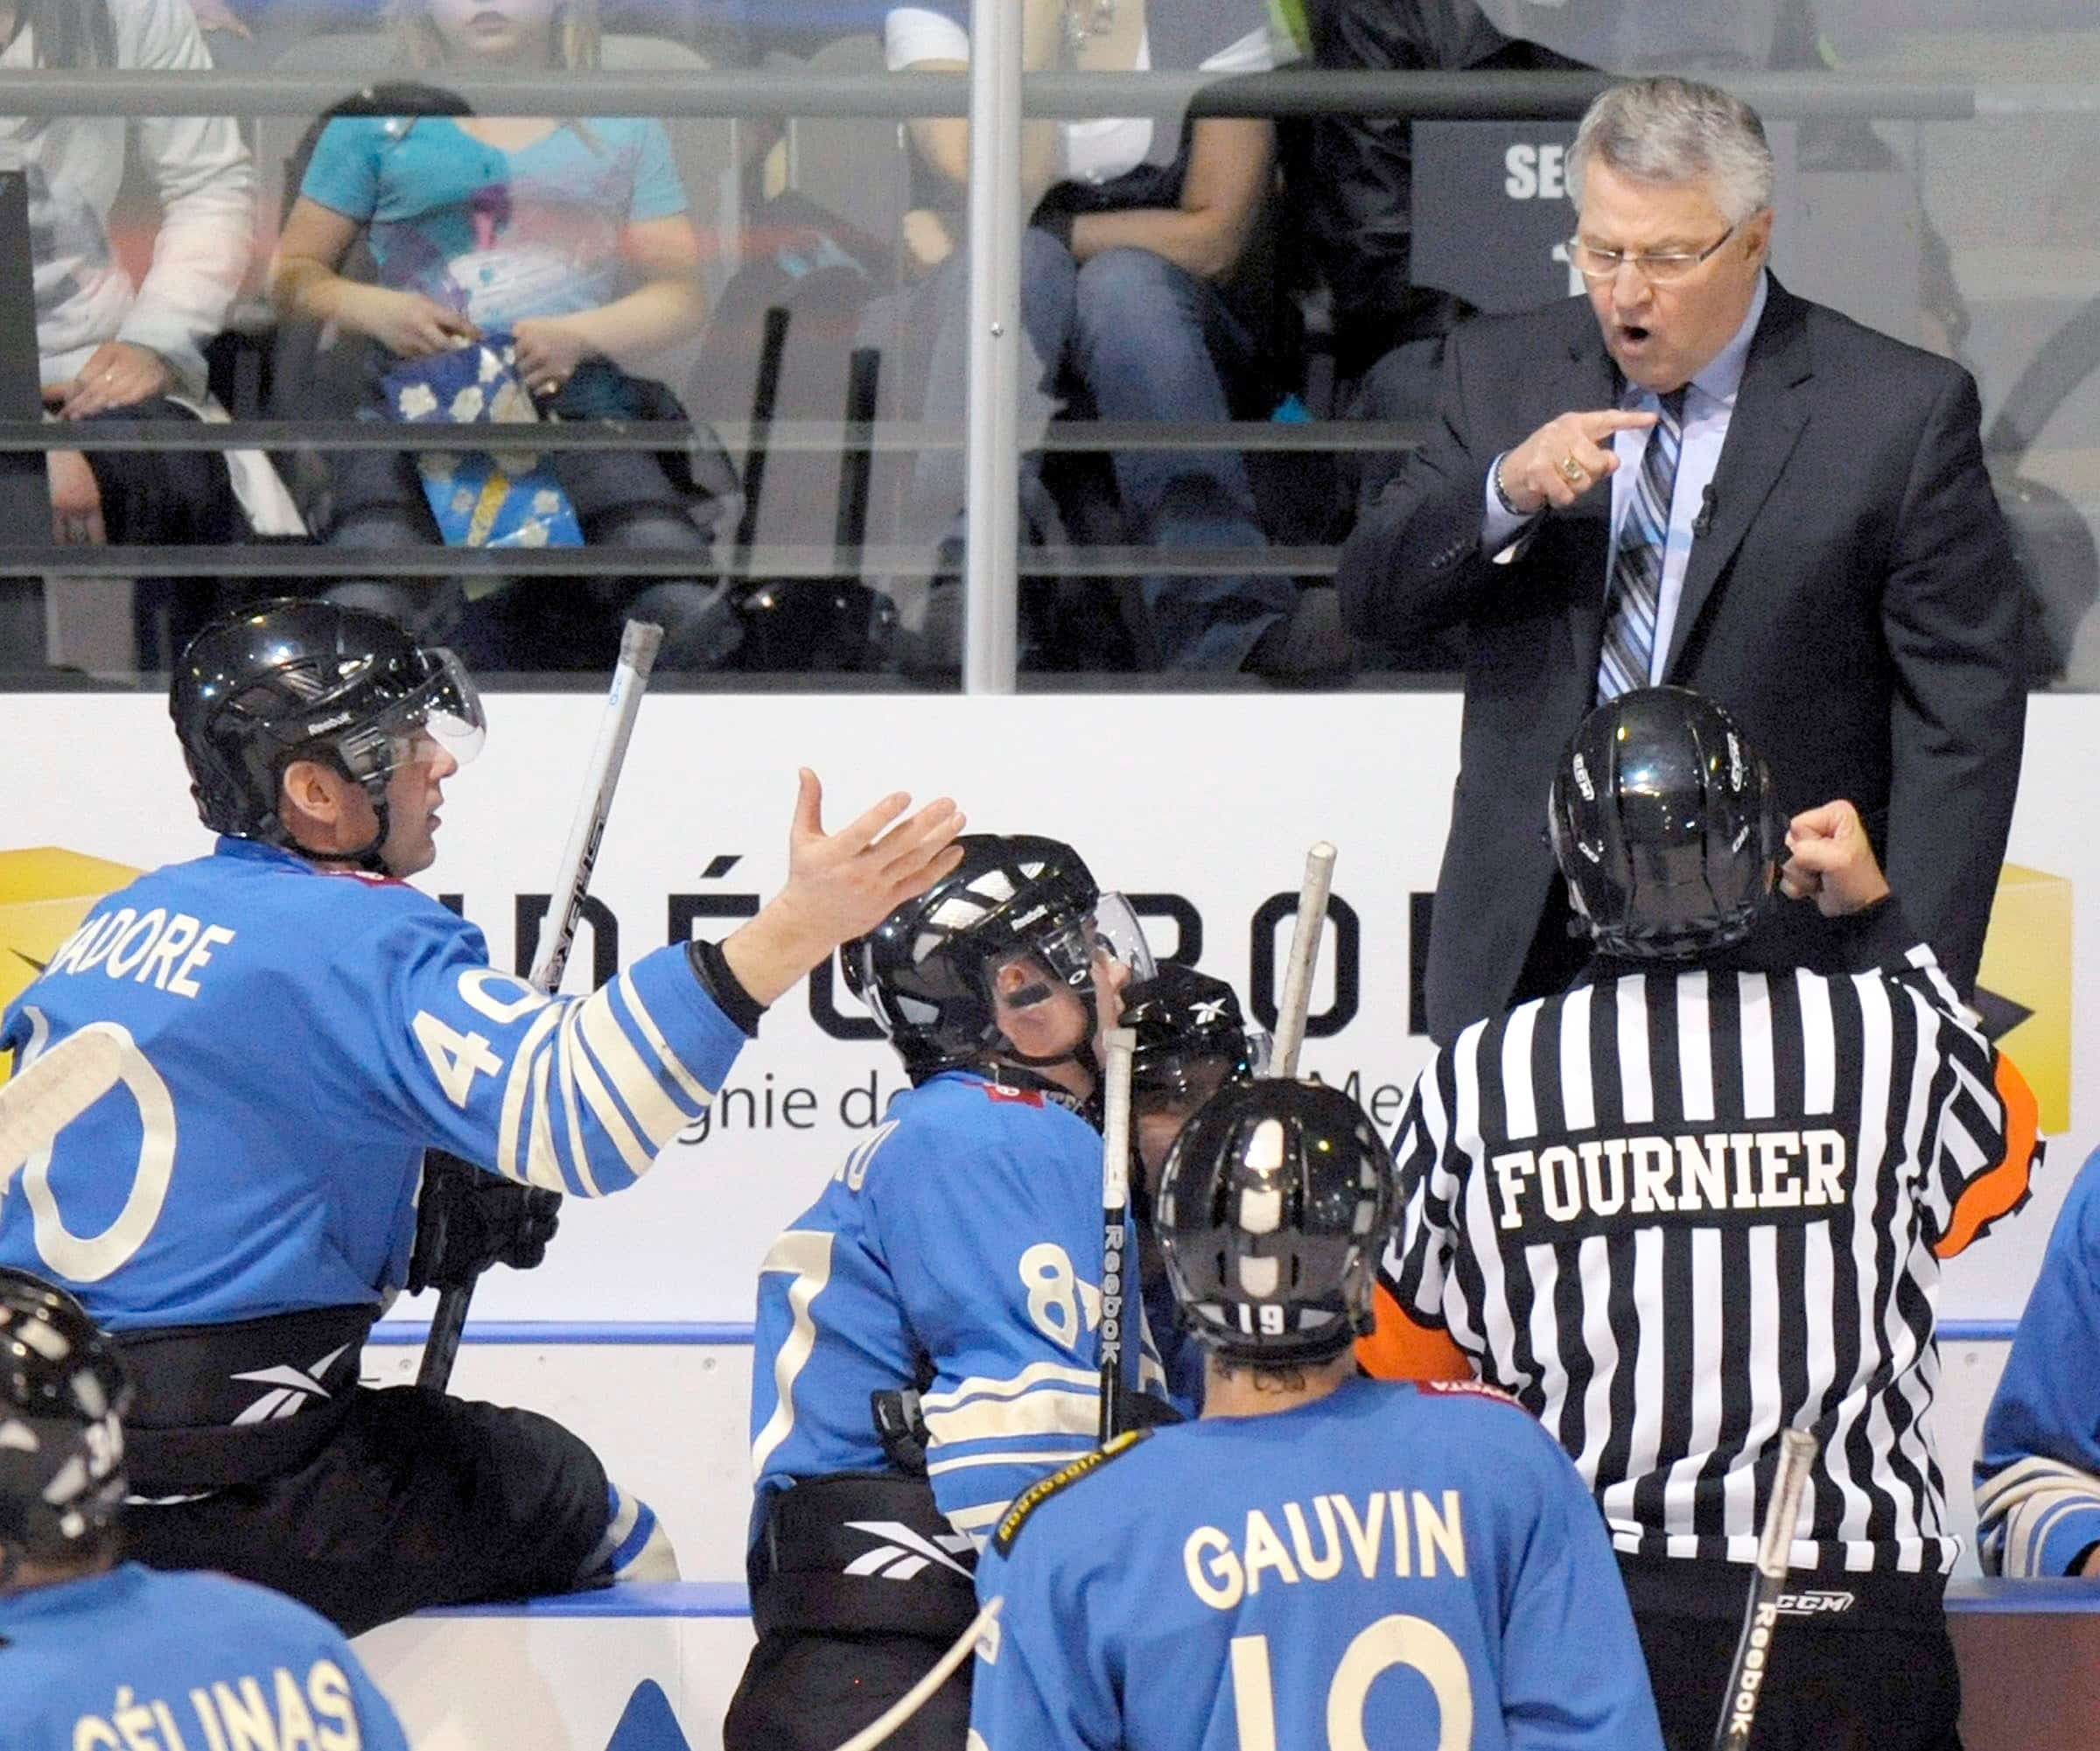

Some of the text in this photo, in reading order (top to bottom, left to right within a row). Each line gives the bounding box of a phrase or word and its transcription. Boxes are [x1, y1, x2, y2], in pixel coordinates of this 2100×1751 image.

[1492, 1129, 1846, 1229] FOURNIER
[1102, 1224, 1124, 1364] Reebok
[1238, 1303, 1284, 1334] 19
[1183, 1488, 1467, 1611] GAUVIN
[1776, 1591, 1855, 1615] CCM
[1729, 1601, 1778, 1734] Reebok
